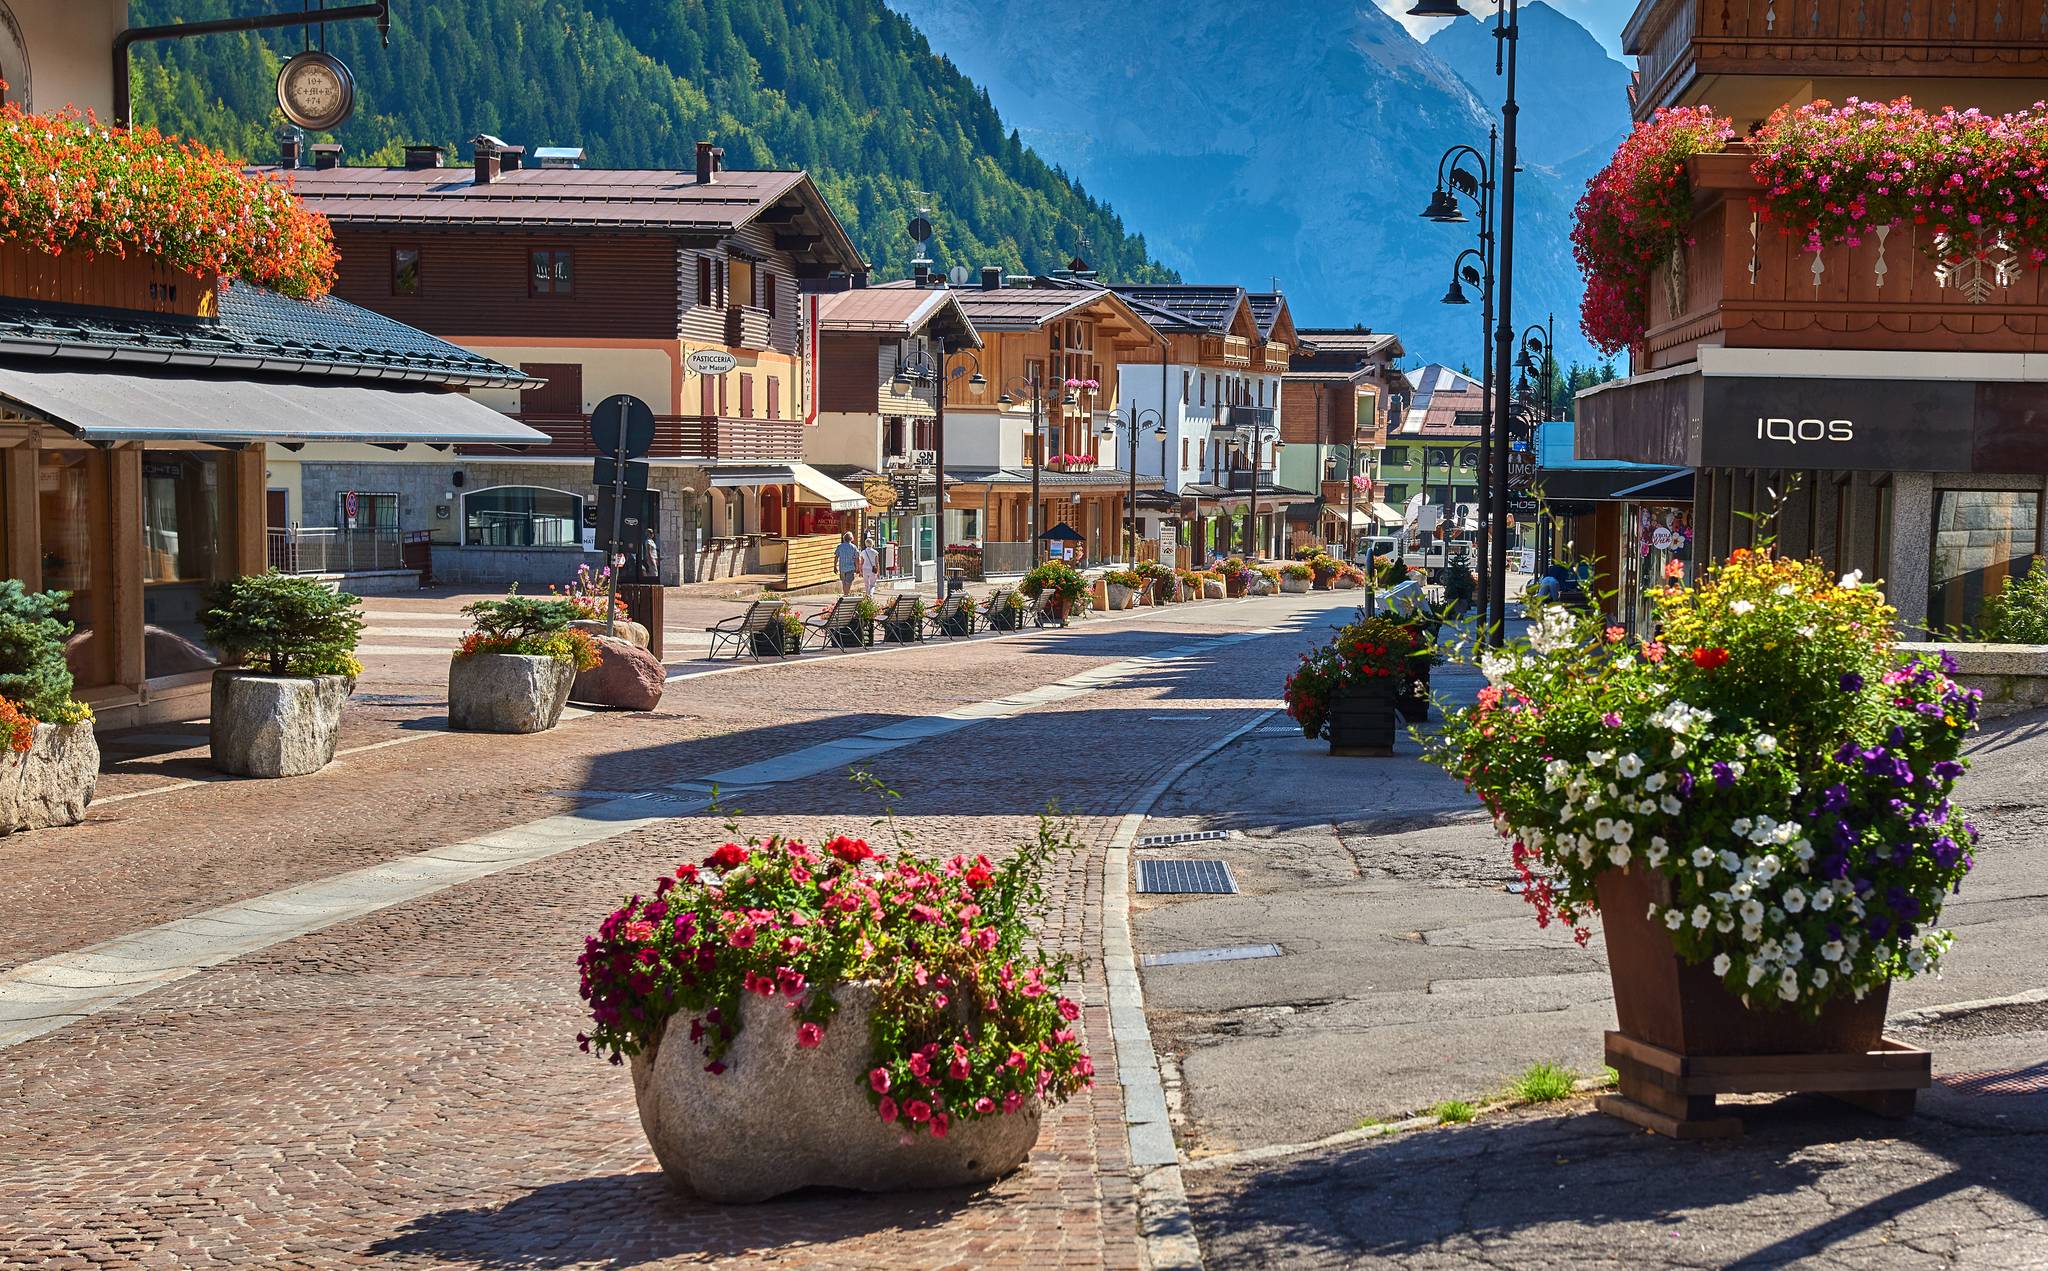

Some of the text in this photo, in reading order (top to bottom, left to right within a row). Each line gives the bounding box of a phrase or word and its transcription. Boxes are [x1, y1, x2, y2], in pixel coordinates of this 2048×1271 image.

[692, 355, 732, 363] PASTICCERIA
[1757, 418, 1853, 445] IQOS
[919, 451, 934, 460] ON
